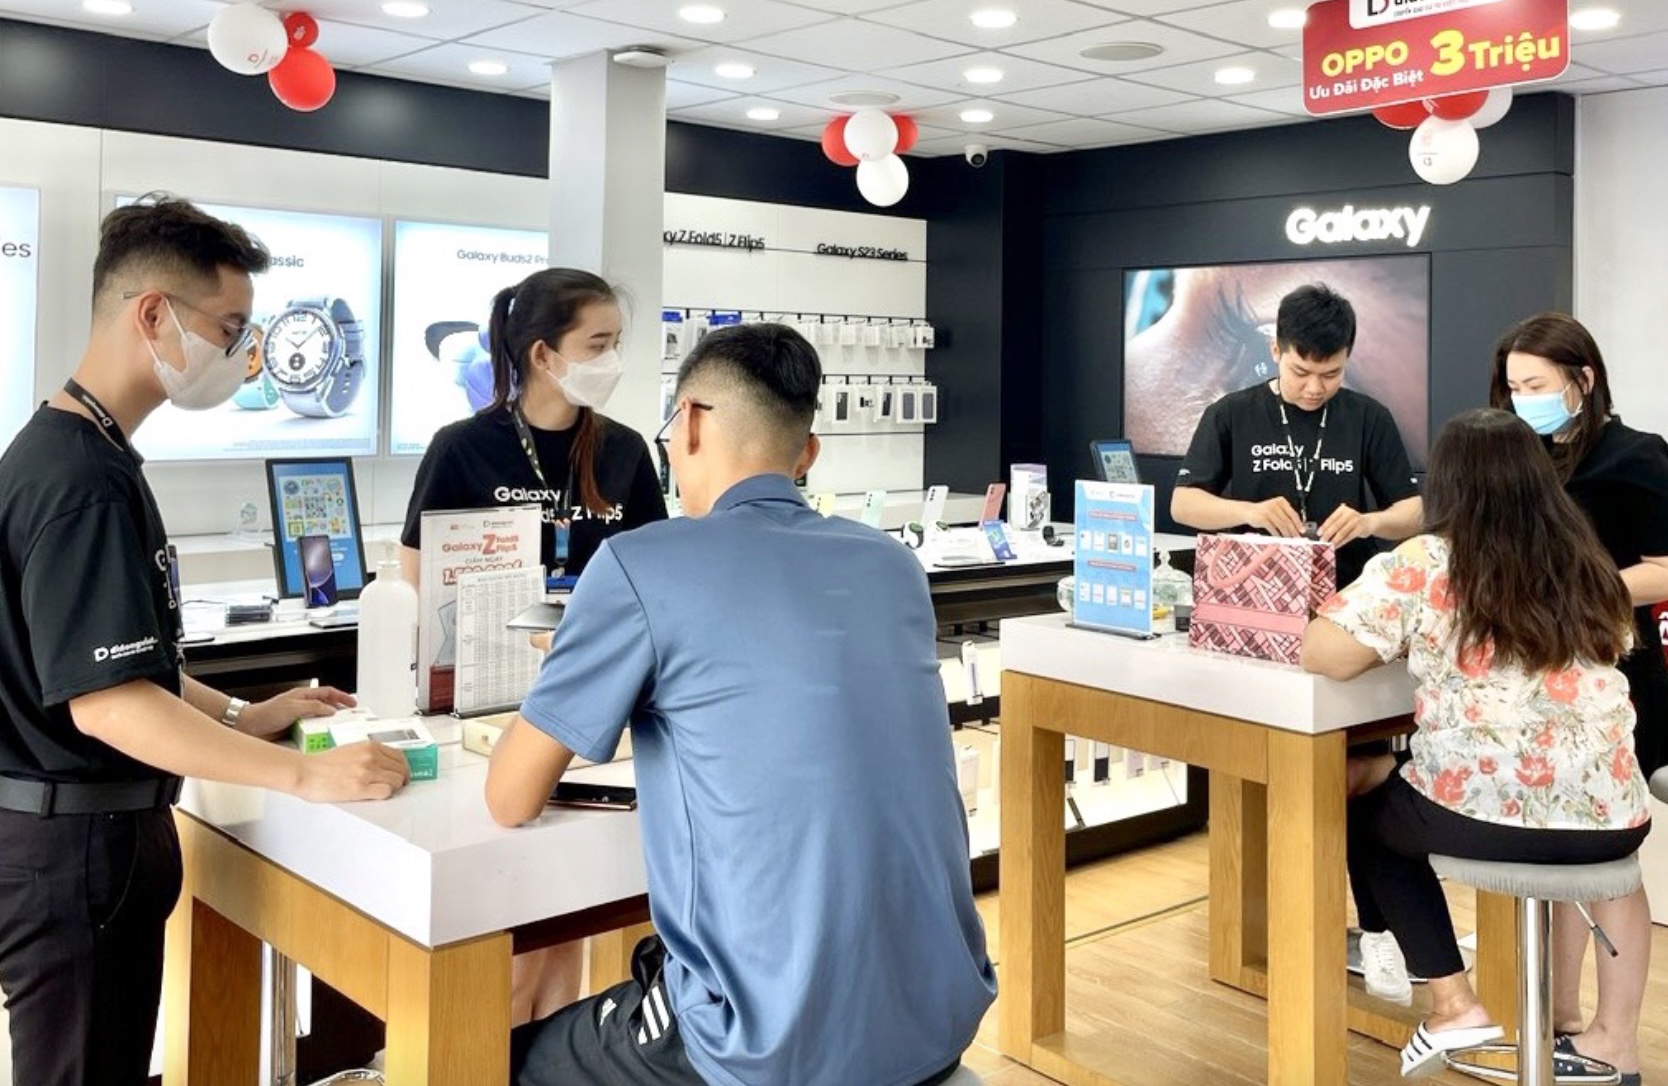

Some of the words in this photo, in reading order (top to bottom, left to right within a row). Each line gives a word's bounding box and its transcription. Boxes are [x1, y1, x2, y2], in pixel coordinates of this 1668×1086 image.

[1321, 41, 1409, 77] OPPO
[1429, 30, 1466, 76] 3
[1468, 32, 1560, 71] Triệu
[1309, 85, 1330, 99] Ưu
[1361, 76, 1389, 94] Đặc
[1393, 70, 1424, 87] Biệt
[1285, 205, 1431, 247] Galaxy
[689, 230, 722, 246] Fold5
[738, 234, 765, 252] Flip5
[457, 249, 499, 264] Galaxy
[500, 252, 533, 264] Buds2
[817, 243, 857, 260] Galaxy
[858, 246, 876, 259] S23
[877, 248, 908, 261] Series
[1252, 459, 1261, 473] Z
[1320, 458, 1354, 475] Flip5
[493, 485, 561, 502] Galaxy
[571, 506, 584, 520] Z
[442, 542, 483, 553] Galaxy
[482, 533, 497, 555] Z
